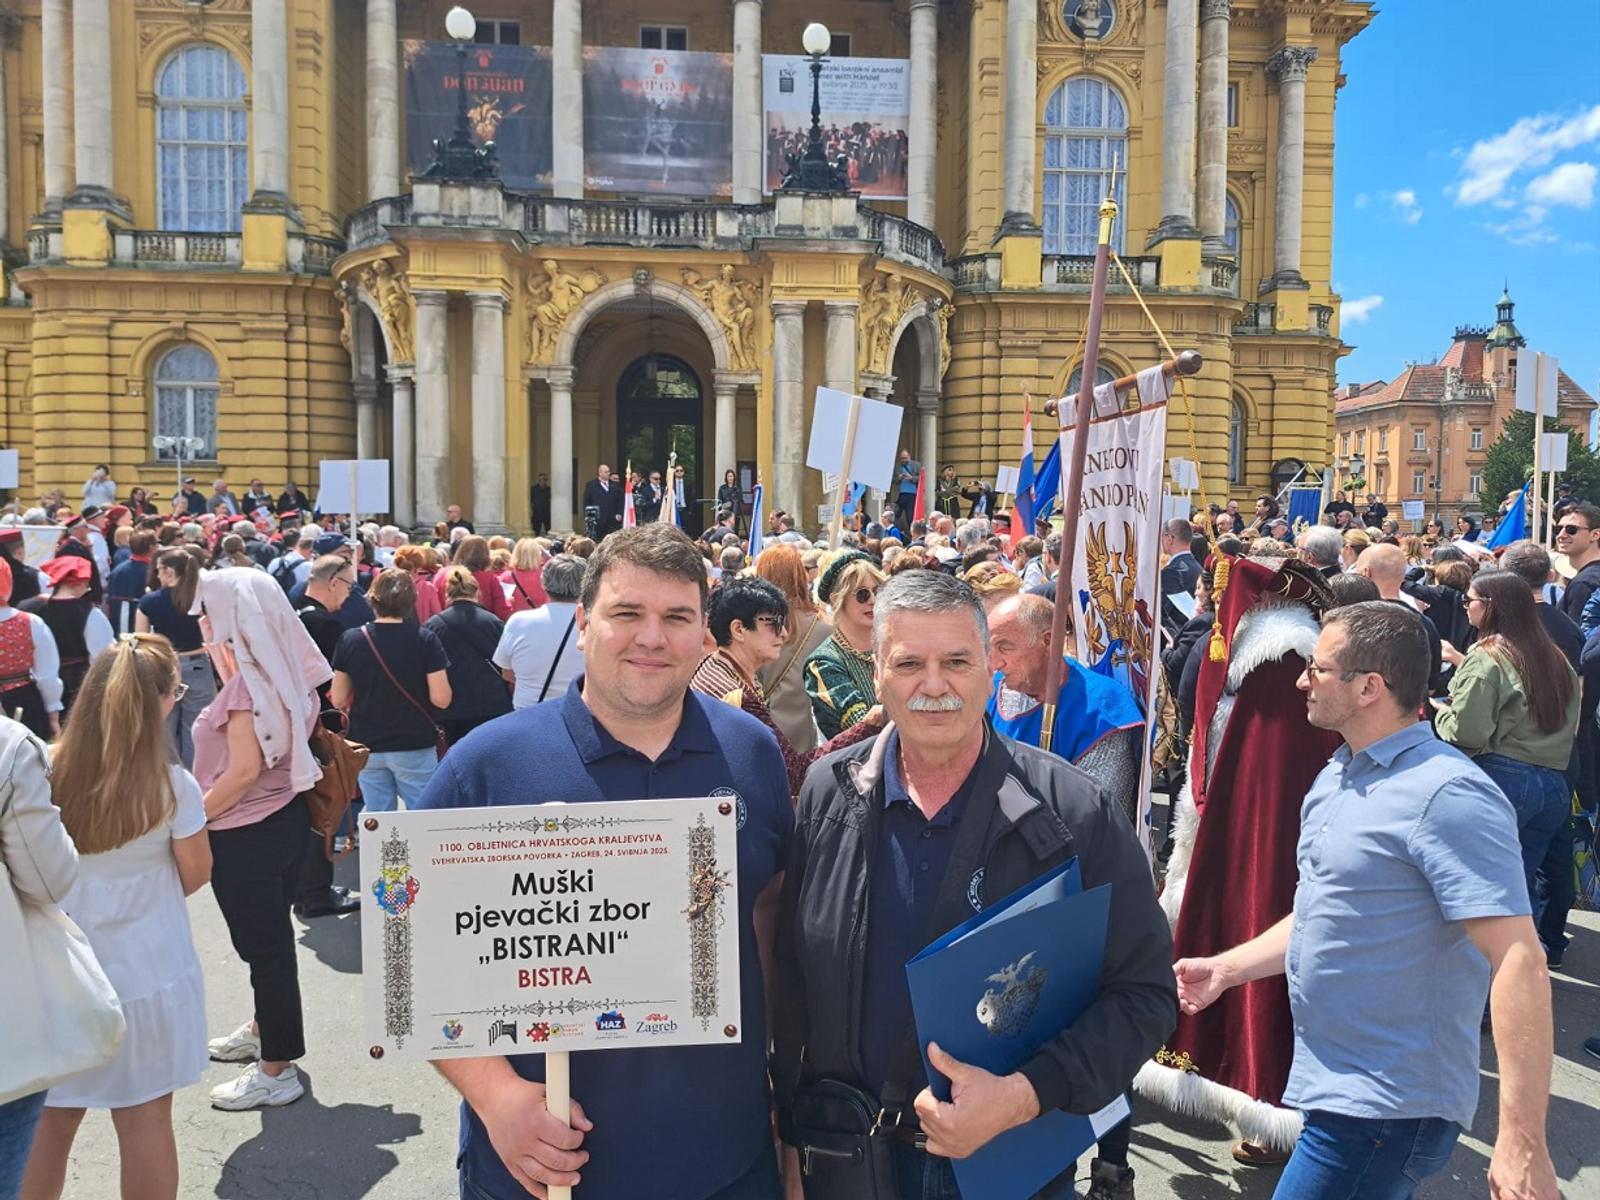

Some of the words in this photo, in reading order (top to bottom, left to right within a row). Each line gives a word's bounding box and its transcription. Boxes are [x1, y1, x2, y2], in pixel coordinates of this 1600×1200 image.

[439, 842, 465, 852] 1100.
[467, 839, 526, 851] OBLJETNICA
[529, 836, 596, 848] HRVATSKOGA
[598, 834, 663, 845] KRALJEVSTVA
[431, 856, 485, 866] SVEHRVATSKA
[487, 854, 522, 863] ZBORSKA
[523, 852, 562, 861] POVORKA
[617, 848, 648, 857] SVIBNJA
[511, 868, 594, 896] Muški
[455, 899, 579, 935] pjevački
[589, 898, 651, 922] zbor
[517, 965, 592, 988] BISTRA
[600, 1020, 622, 1030] HAZ
[635, 1019, 678, 1035] Zagreb
